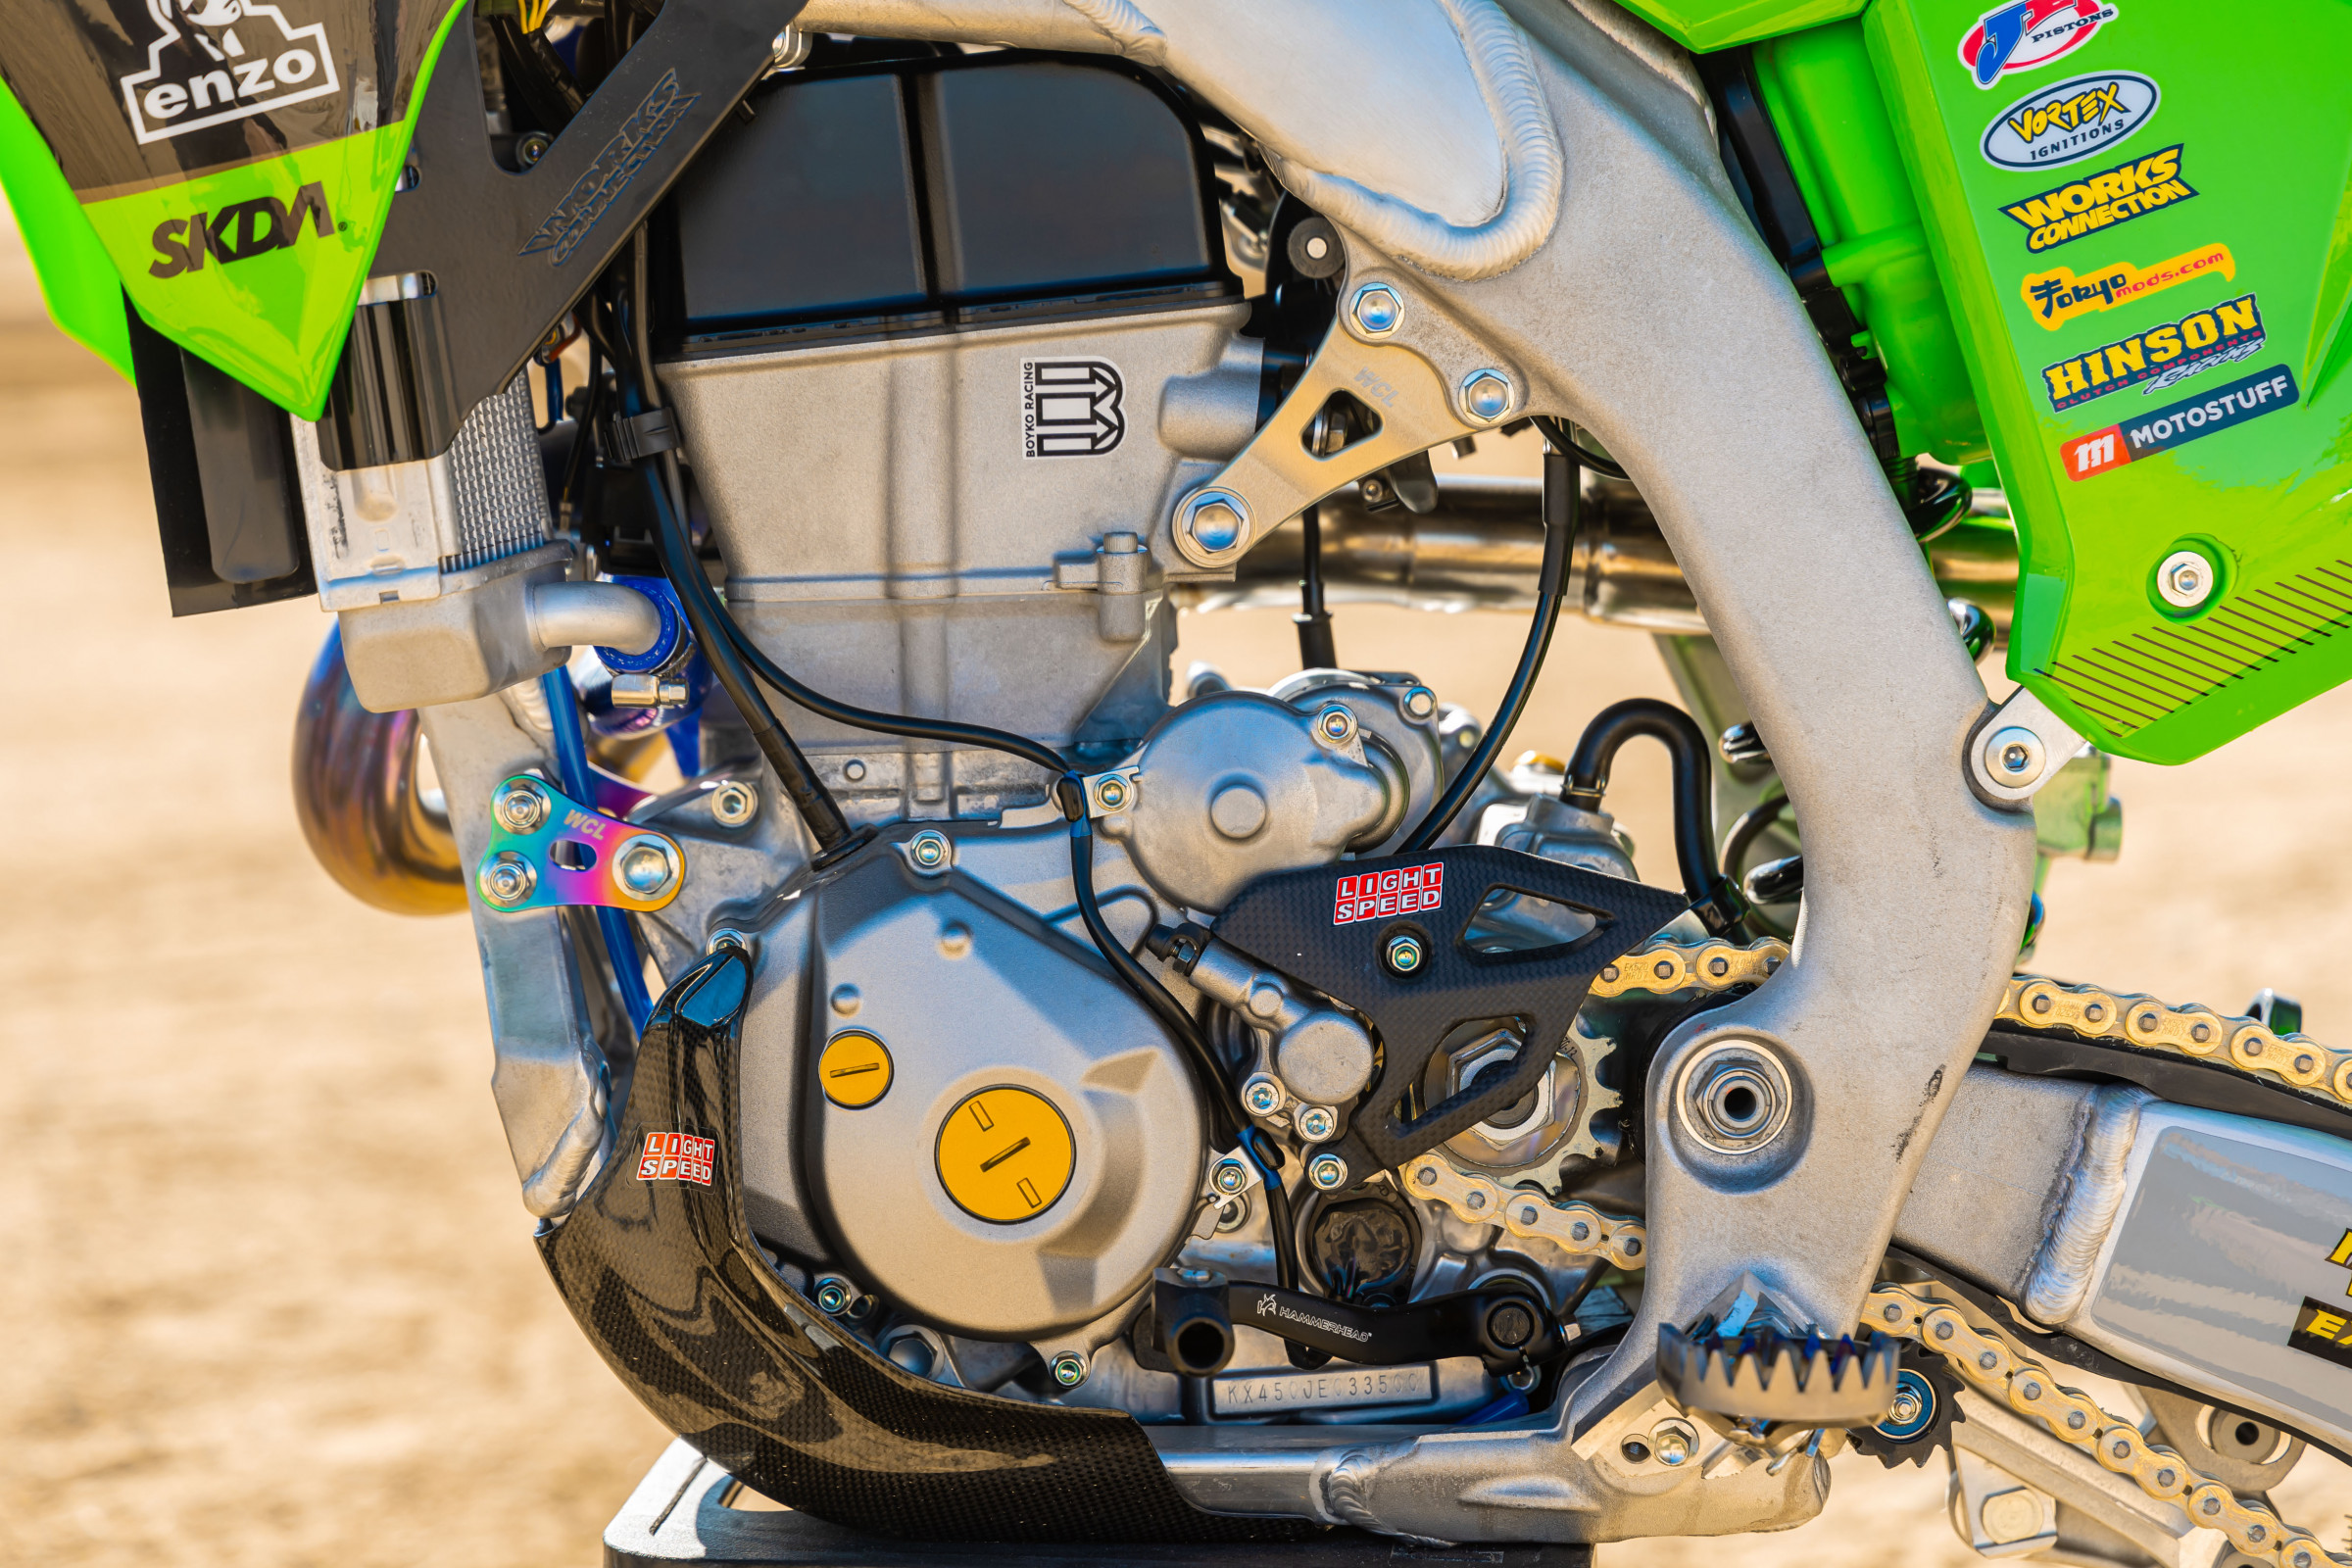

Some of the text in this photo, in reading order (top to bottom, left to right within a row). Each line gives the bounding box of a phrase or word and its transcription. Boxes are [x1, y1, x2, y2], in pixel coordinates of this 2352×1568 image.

[2032, 8, 2114, 44] PISTONS
[144, 49, 317, 120] enzo
[2008, 81, 2132, 143] VORTEX
[2031, 119, 2125, 161] IGNITIONS
[2007, 148, 2180, 229] WORKS
[148, 180, 336, 279] SKDA
[2029, 179, 2192, 251] CONNECTION
[2116, 252, 2225, 298] mods.com
[2045, 297, 2258, 401] HINSON
[2056, 330, 2262, 410] CLUTCH COMPONENTS
[1023, 362, 1036, 458] BOYKO RACING
[1354, 366, 1399, 409] WCL
[2130, 375, 2288, 449] MOTOSTUFF
[564, 808, 607, 841] WCL
[1336, 890, 1441, 920] SPEED
[1340, 867, 1442, 898] LIGHT
[640, 1158, 712, 1181] SPEED
[647, 1136, 713, 1160] LIGHT
[1279, 1305, 1369, 1343] HAMMERHEAD
